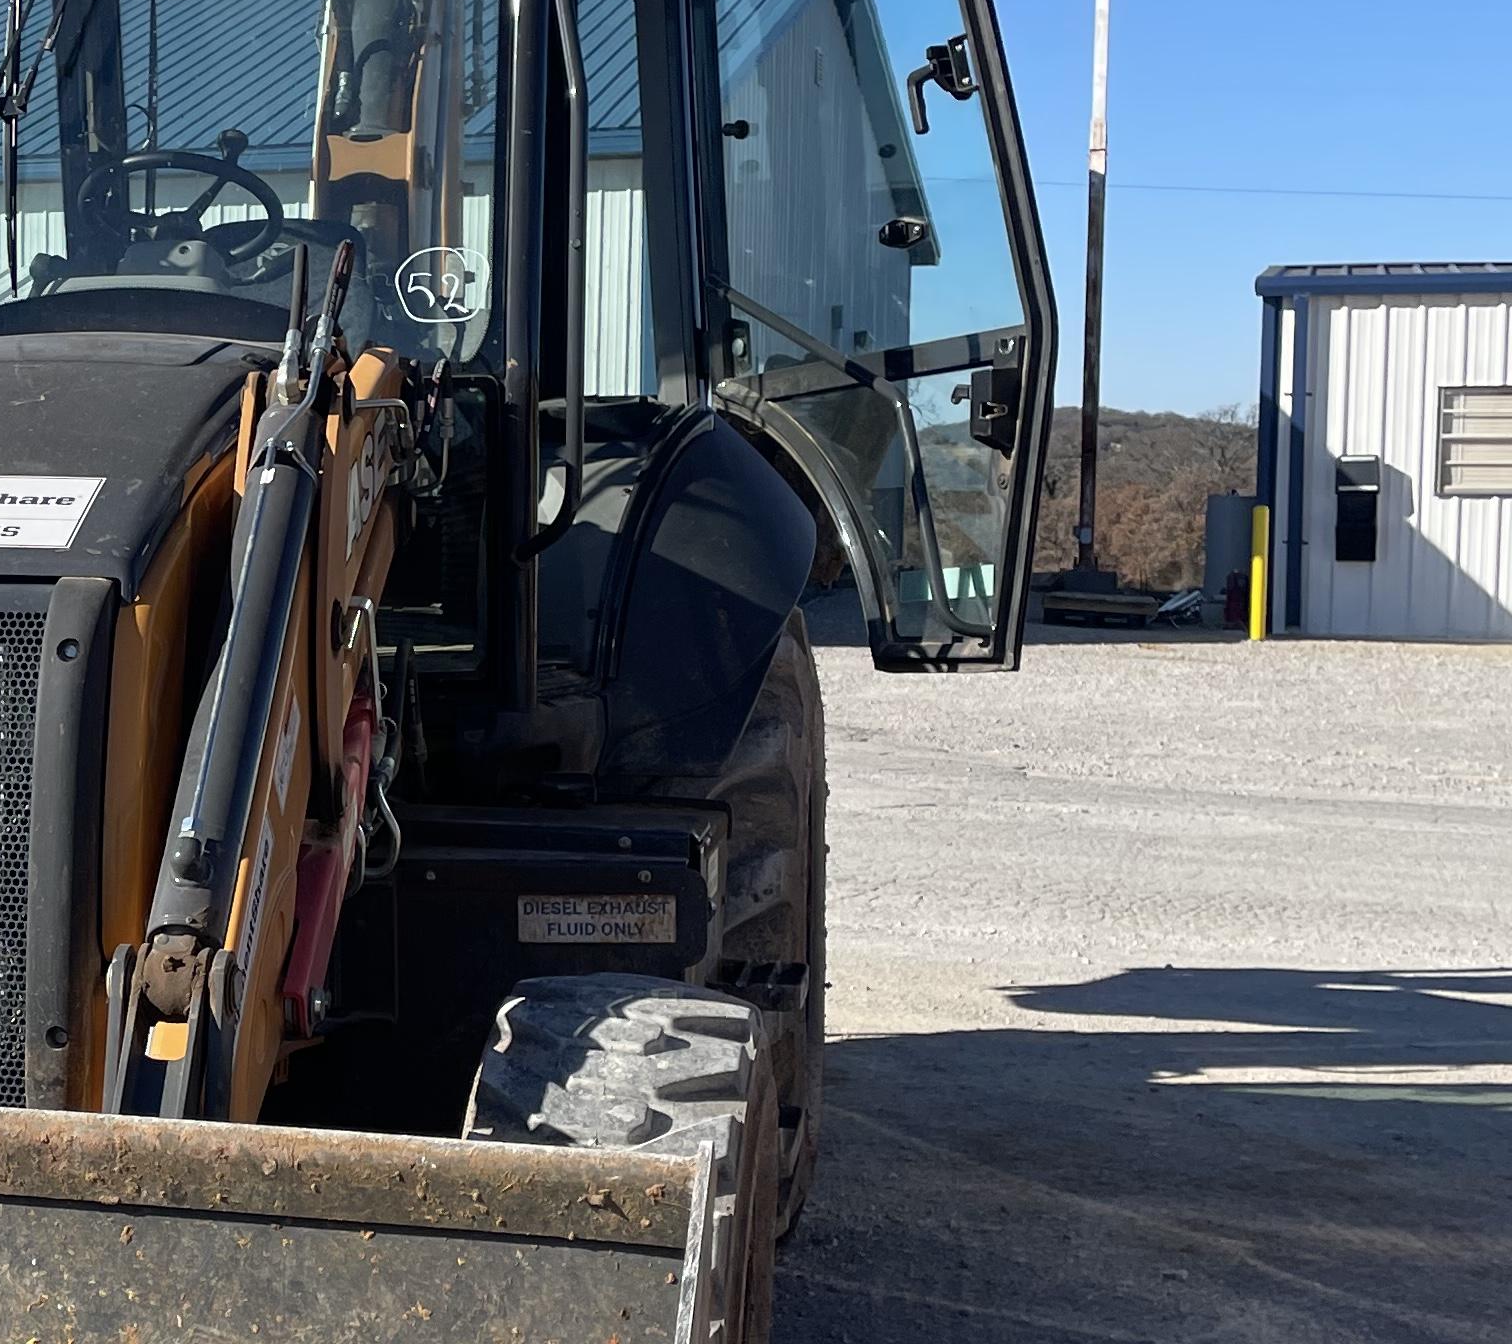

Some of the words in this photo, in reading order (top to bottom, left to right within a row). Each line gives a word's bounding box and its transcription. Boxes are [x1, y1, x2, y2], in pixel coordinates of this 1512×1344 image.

[407, 272, 469, 314] 52
[346, 407, 387, 563] ASE
[522, 901, 583, 915] DIESEL
[588, 901, 670, 915] EXHAUST
[546, 922, 596, 936] FLUID
[600, 922, 646, 937] ONLY
